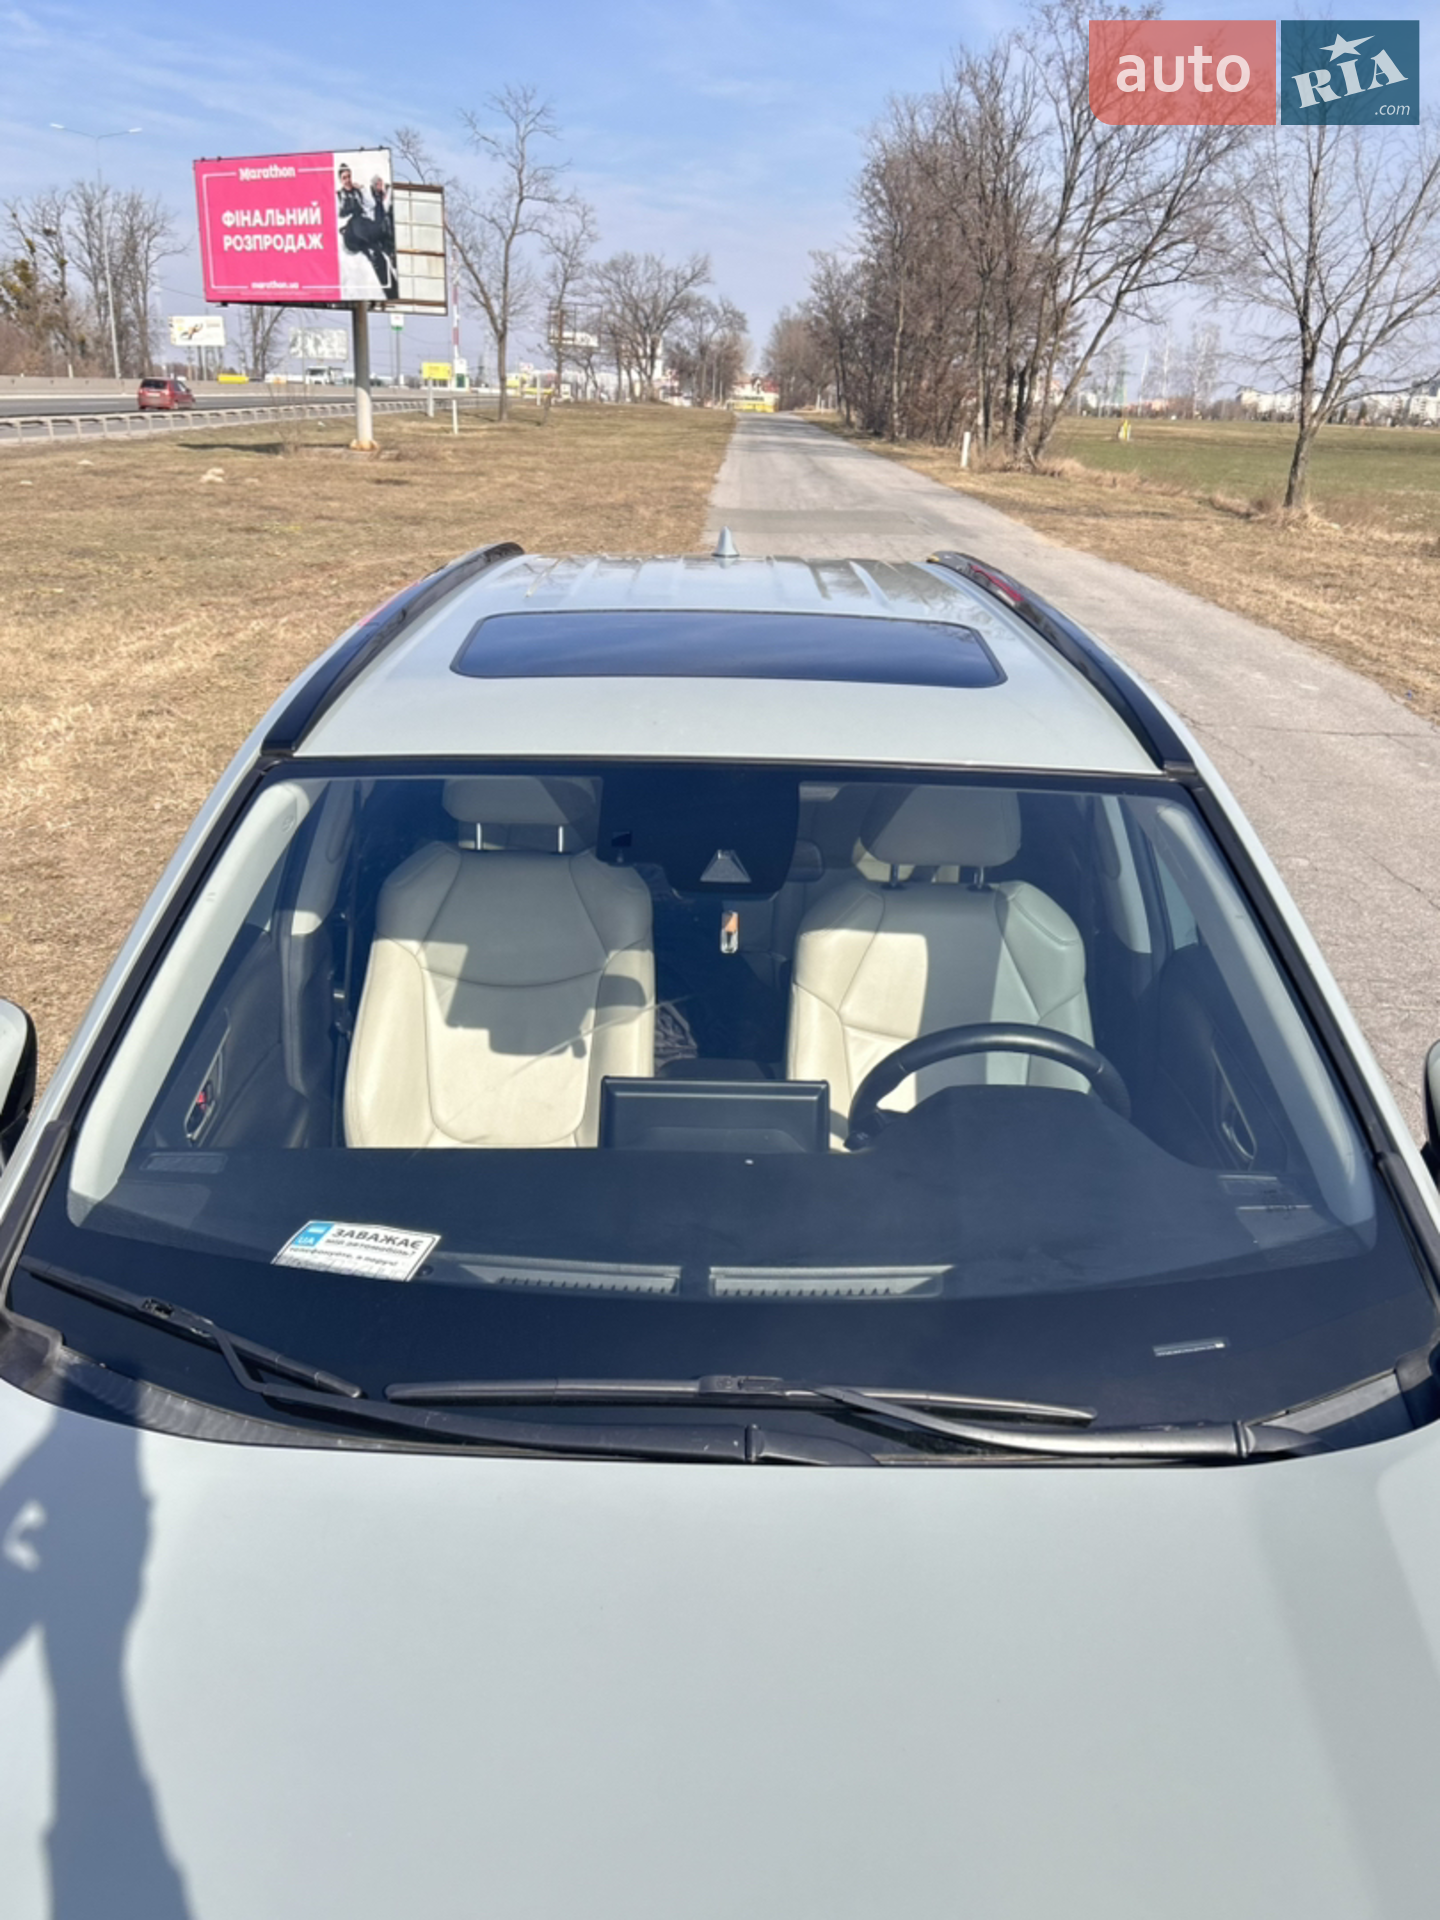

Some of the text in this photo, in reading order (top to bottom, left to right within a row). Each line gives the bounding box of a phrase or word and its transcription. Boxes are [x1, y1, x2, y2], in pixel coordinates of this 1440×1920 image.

[239, 165, 295, 181] Marathon
[221, 201, 322, 228] ФІНАЛЬНИЙ
[223, 233, 323, 253] РОЗПРОДАЖ
[298, 1236, 316, 1245] UA
[332, 1228, 424, 1251] ЗАВАЖАЄ
